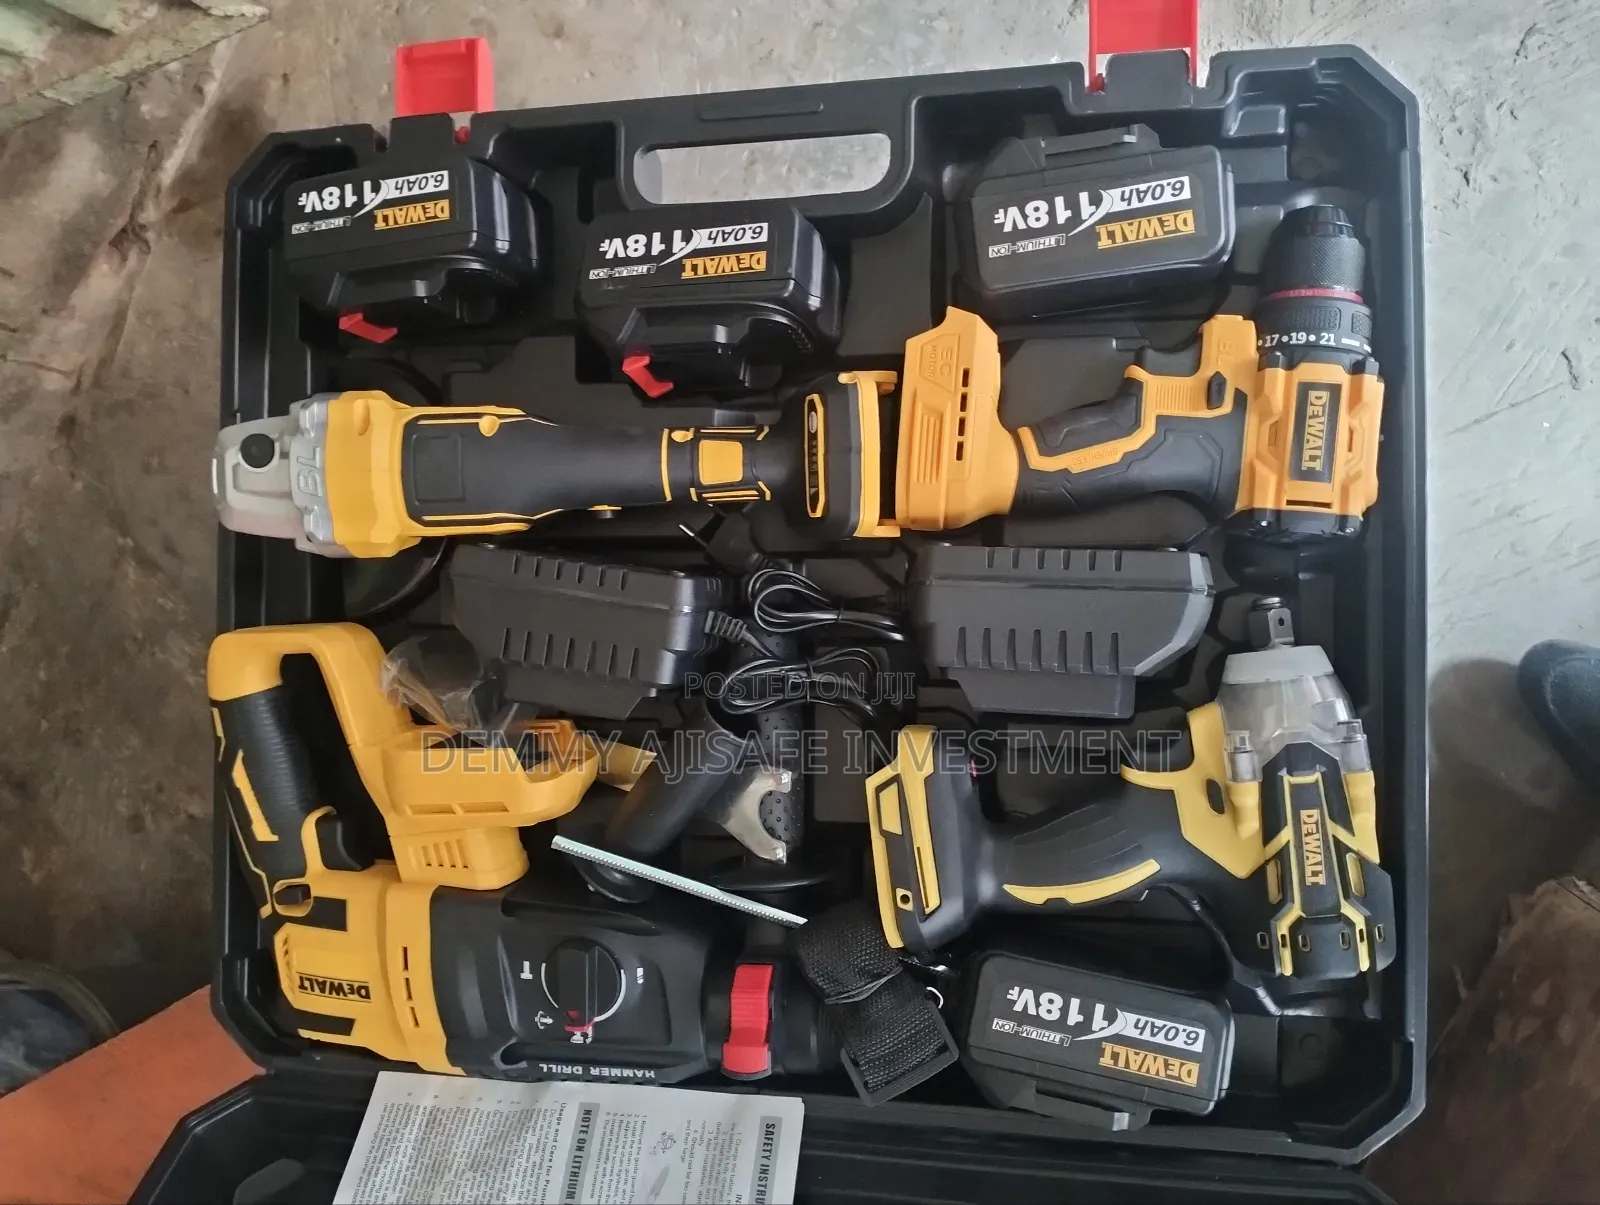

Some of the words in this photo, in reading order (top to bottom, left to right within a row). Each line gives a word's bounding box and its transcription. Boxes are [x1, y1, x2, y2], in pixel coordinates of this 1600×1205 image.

[394, 173, 446, 193] 6.0Ah
[1119, 179, 1186, 207] 6.0Ah
[374, 199, 450, 230] DEWALT
[706, 224, 765, 244] 6.0Ah
[1096, 210, 1196, 249] DEWALT
[988, 234, 1066, 258] LITHIUM-ION
[681, 251, 767, 279] DEWALT
[1301, 390, 1330, 471] DEWALT
[296, 447, 322, 497] BL
[1300, 810, 1326, 885] DEWALT
[296, 972, 372, 1003] DEWALT
[992, 1018, 1072, 1047] LITHIUM-ION
[1132, 1017, 1201, 1047] 6.0Ah
[538, 1063, 583, 1075] DRILL
[590, 1065, 656, 1078] HAMMER
[1099, 1042, 1199, 1087] DEWALT
[555, 1102, 566, 1125] Usage
[579, 1109, 592, 1134] NOTE
[575, 1138, 587, 1151] ON
[761, 1123, 775, 1161] SAFETY
[565, 1155, 583, 1199] LITHIUM
